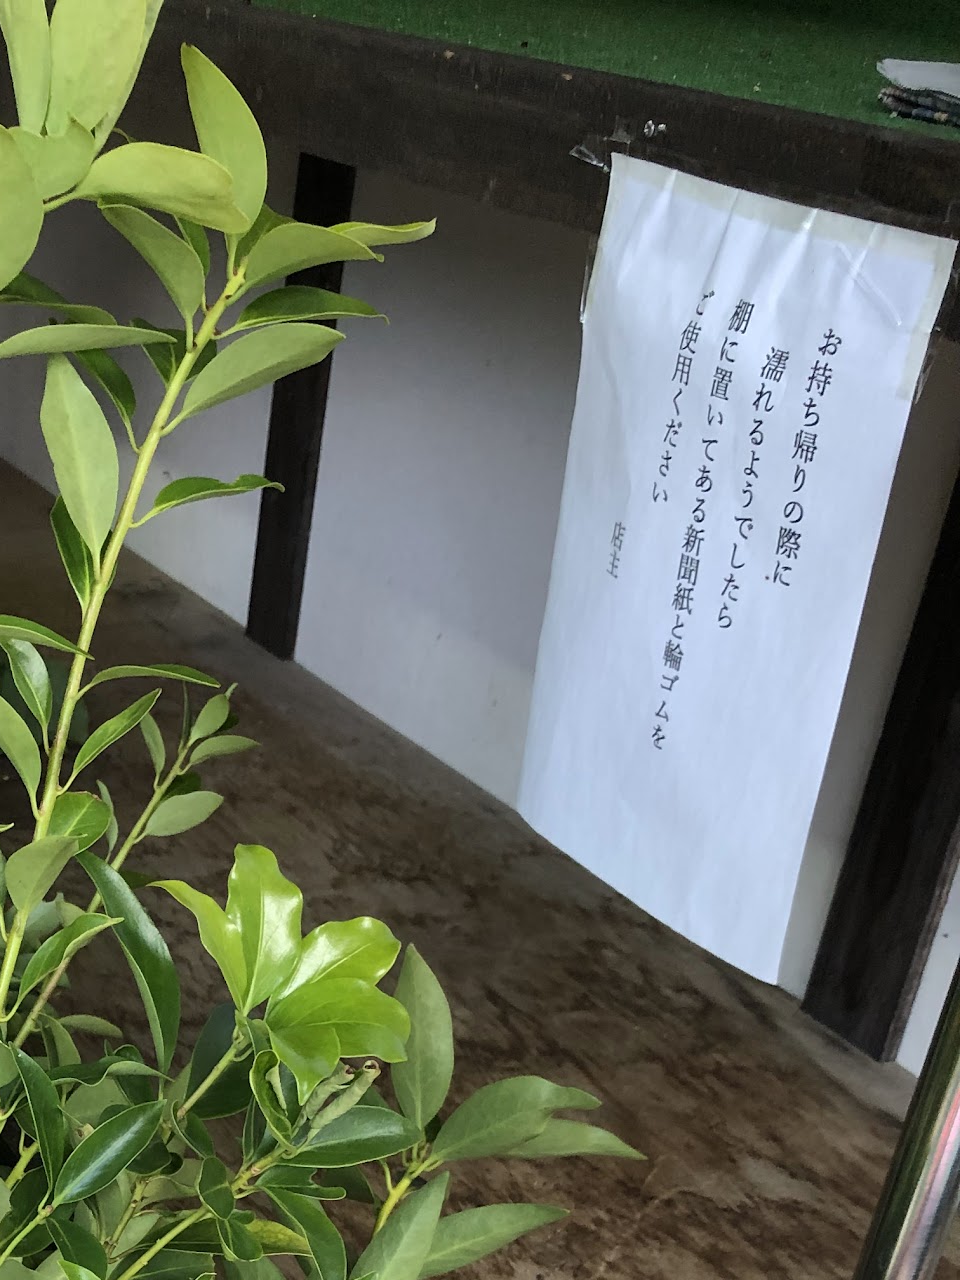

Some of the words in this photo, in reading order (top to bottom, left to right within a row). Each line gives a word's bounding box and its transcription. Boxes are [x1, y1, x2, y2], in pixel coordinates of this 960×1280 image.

[651, 298, 755, 751] 棚に置いてある新聞紙と輪ゴムを
[652, 289, 716, 504] ご使用ください
[717, 346, 790, 629] 濡れるようでしたら
[772, 328, 843, 587] お持ち帰りの際に
[607, 521, 626, 580] 店主
